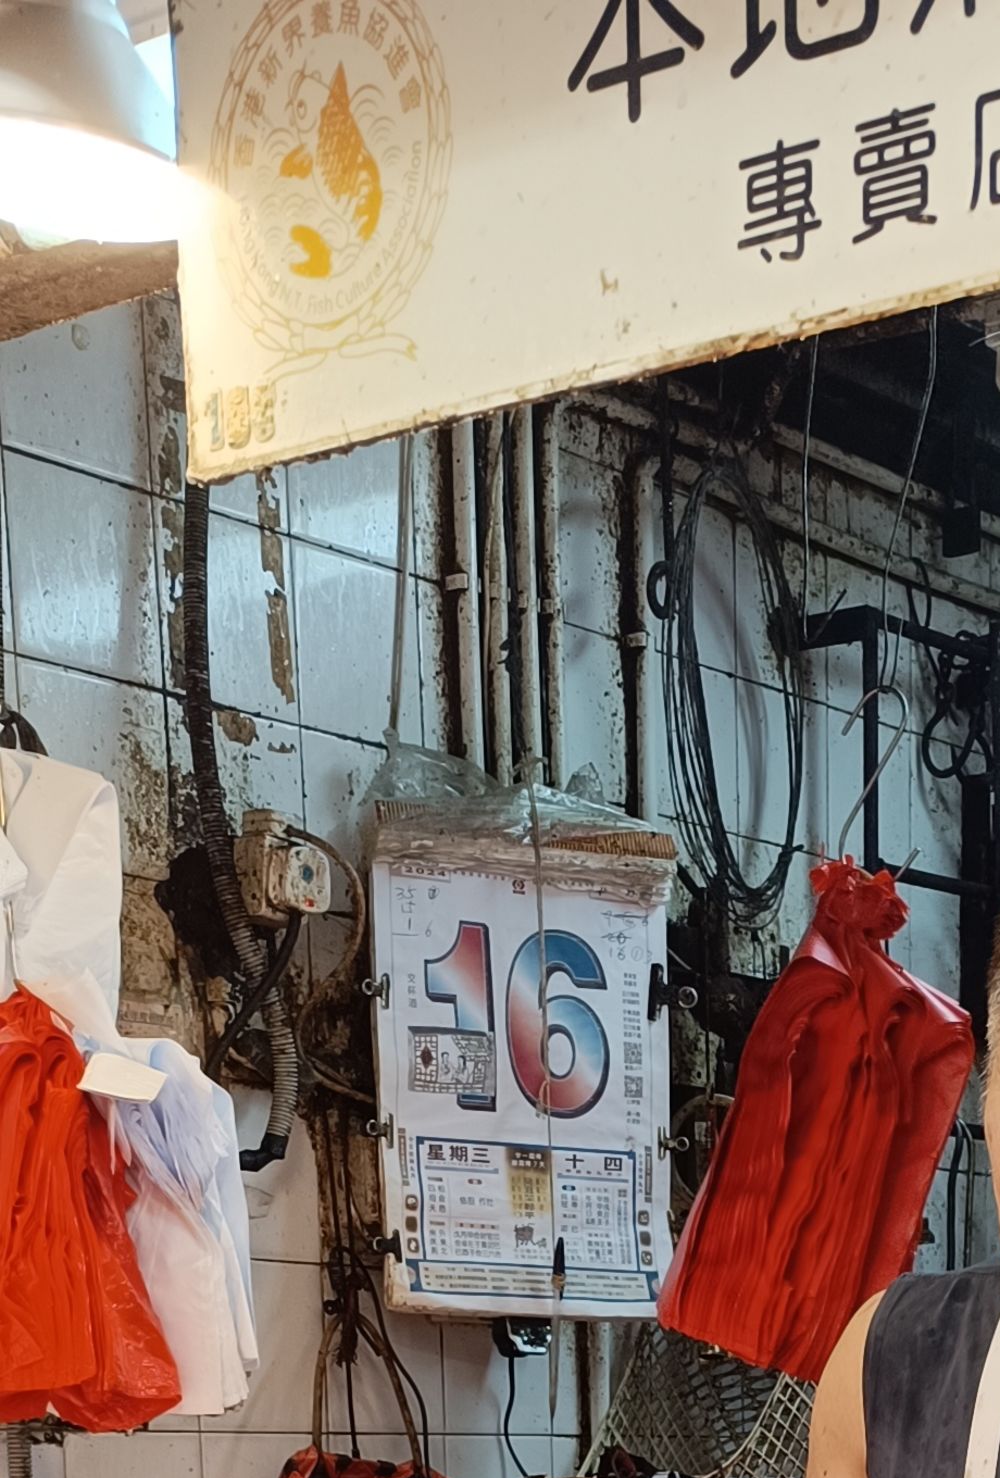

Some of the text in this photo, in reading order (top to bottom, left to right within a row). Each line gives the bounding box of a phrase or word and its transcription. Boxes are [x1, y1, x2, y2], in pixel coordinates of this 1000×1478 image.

[306, 294, 334, 315] Fish
[335, 262, 384, 308] Culture
[380, 140, 423, 266] Association
[404, 865, 447, 879] 2024
[423, 920, 610, 1120] 16
[427, 1143, 491, 1164] 星期三
[564, 1153, 623, 1172] 十四
